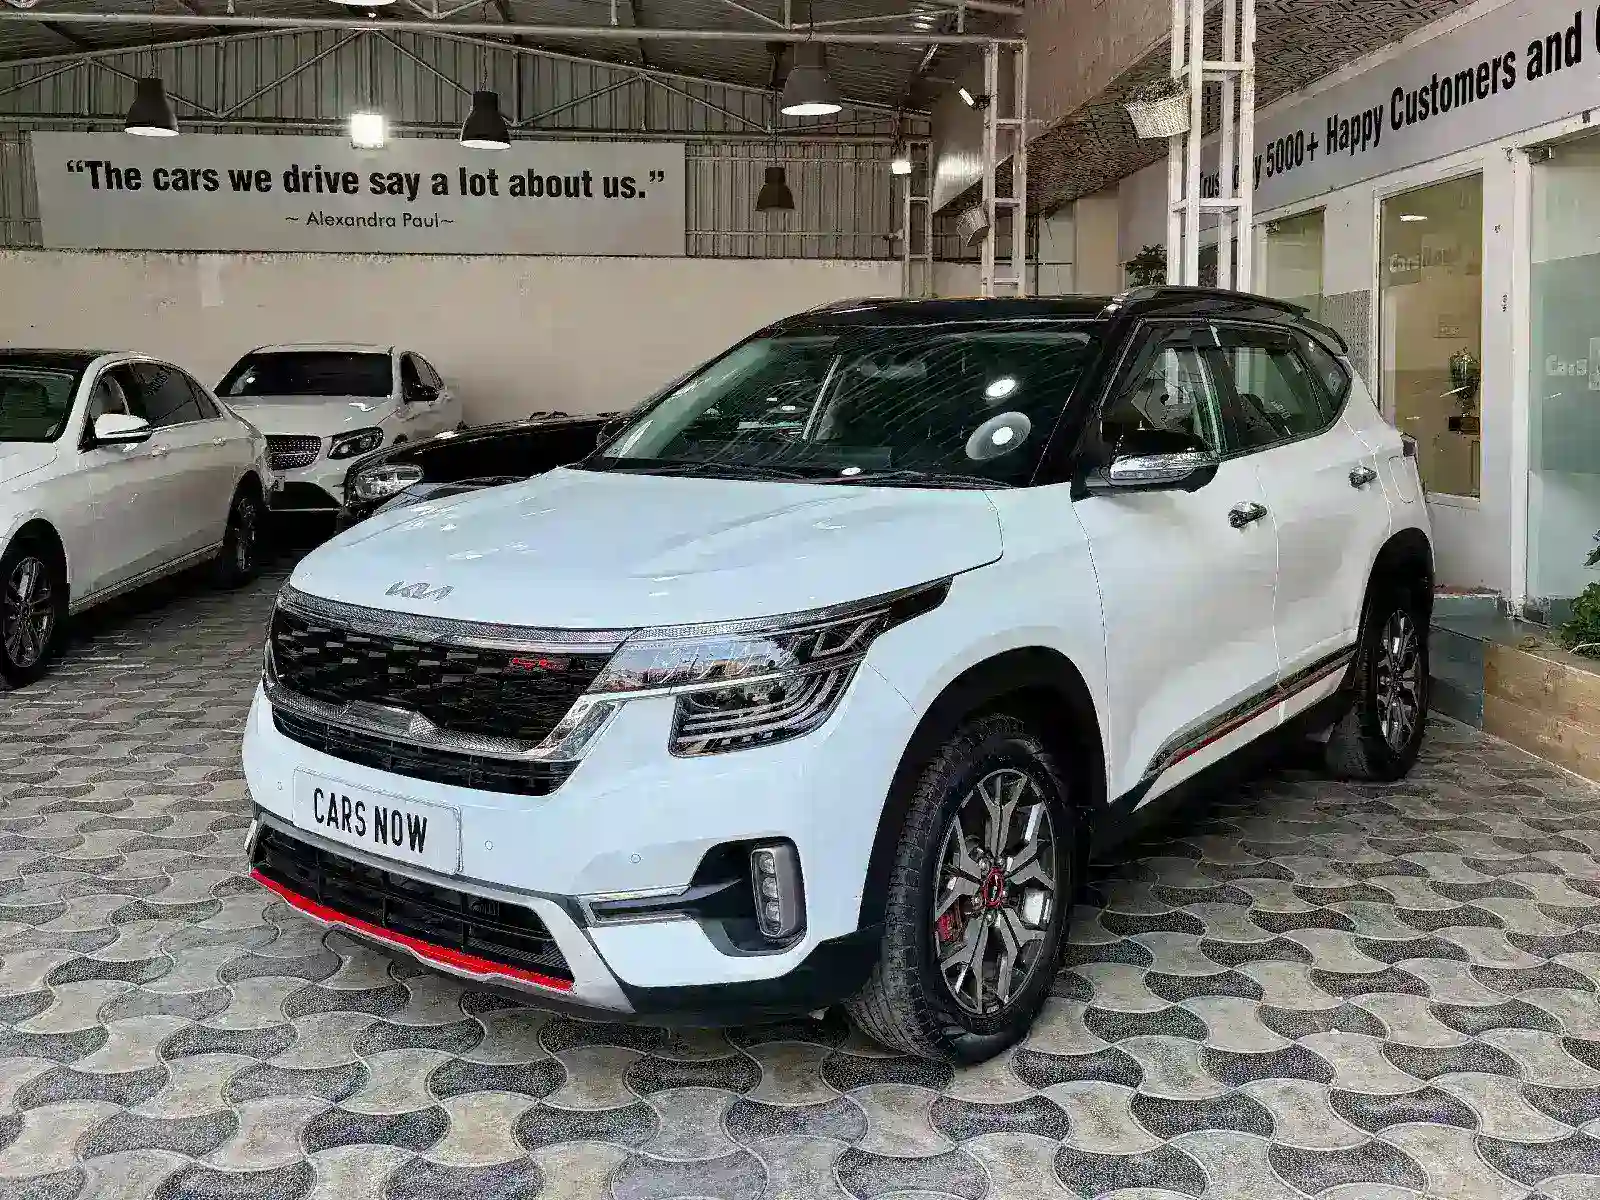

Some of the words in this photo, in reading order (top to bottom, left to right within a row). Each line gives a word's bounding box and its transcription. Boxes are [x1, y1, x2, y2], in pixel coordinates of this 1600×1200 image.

[1266, 129, 1319, 178] 5000+
[1327, 105, 1384, 156] Happy
[1391, 51, 1517, 131] Customers
[1527, 10, 1582, 81] and
[67, 160, 144, 190] “The
[153, 168, 220, 192] cars
[228, 169, 272, 193] we
[283, 164, 359, 195] drive
[369, 173, 420, 202] say
[431, 173, 449, 196] a
[459, 167, 499, 197] lot
[509, 169, 592, 199] about
[603, 170, 665, 199] us.”
[306, 211, 396, 228] Alexandra
[313, 787, 367, 837] CARS
[375, 806, 428, 854] NOW
